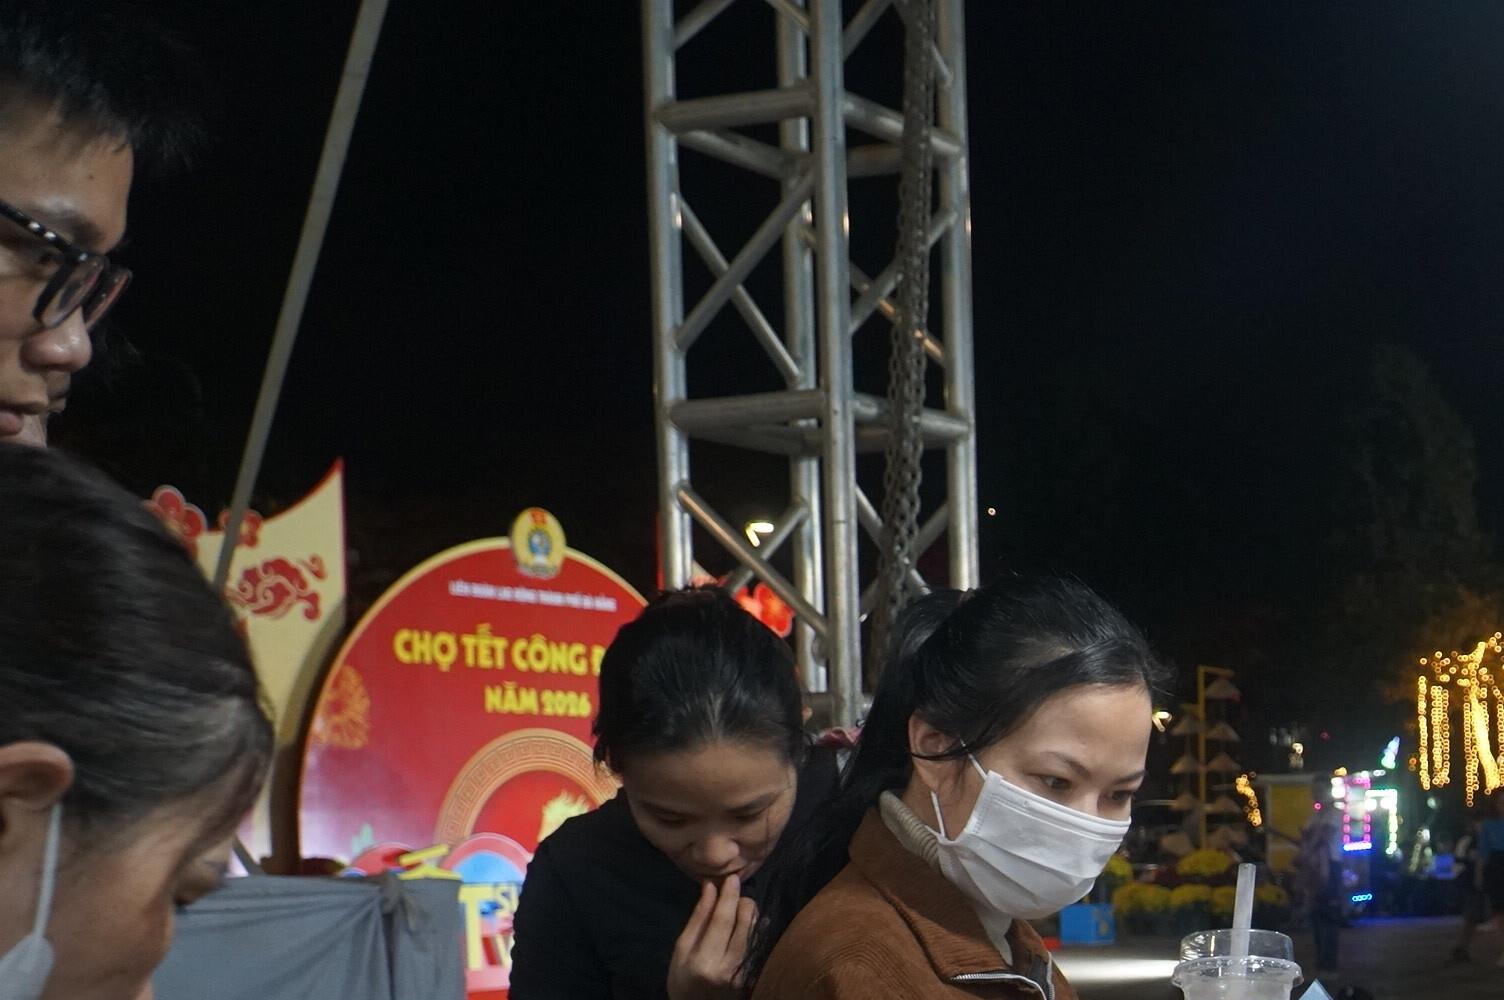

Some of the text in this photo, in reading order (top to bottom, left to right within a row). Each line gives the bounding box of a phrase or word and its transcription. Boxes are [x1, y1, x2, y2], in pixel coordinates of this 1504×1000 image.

[393, 628, 458, 672] CHỢ
[460, 622, 509, 670] TẾT
[511, 633, 589, 676] CÔNG
[484, 680, 539, 715] NĂM
